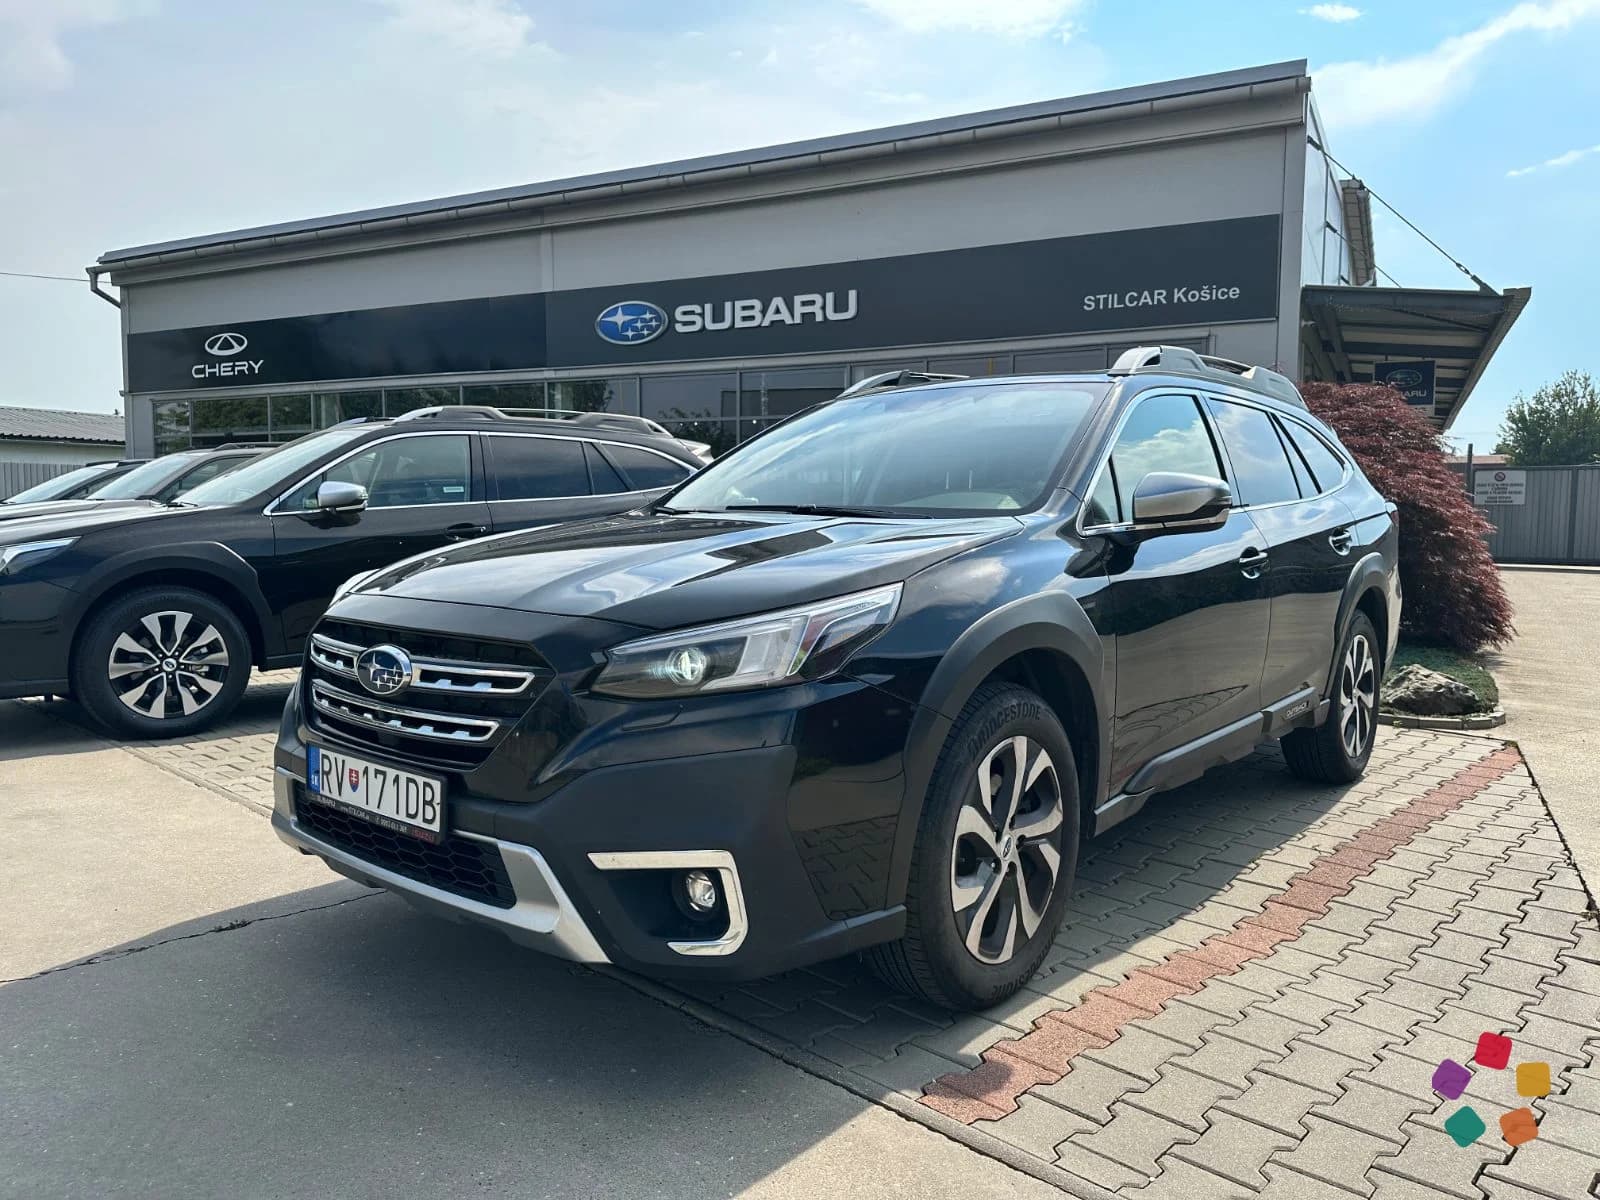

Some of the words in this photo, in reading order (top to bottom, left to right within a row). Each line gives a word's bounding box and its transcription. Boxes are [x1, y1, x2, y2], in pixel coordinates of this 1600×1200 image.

[674, 289, 858, 333] SUBARU
[1083, 289, 1167, 311] STILCAR
[1173, 285, 1240, 303] Košice
[191, 359, 264, 378] CHERY
[321, 753, 345, 796] RV
[362, 765, 437, 825] 171DB
